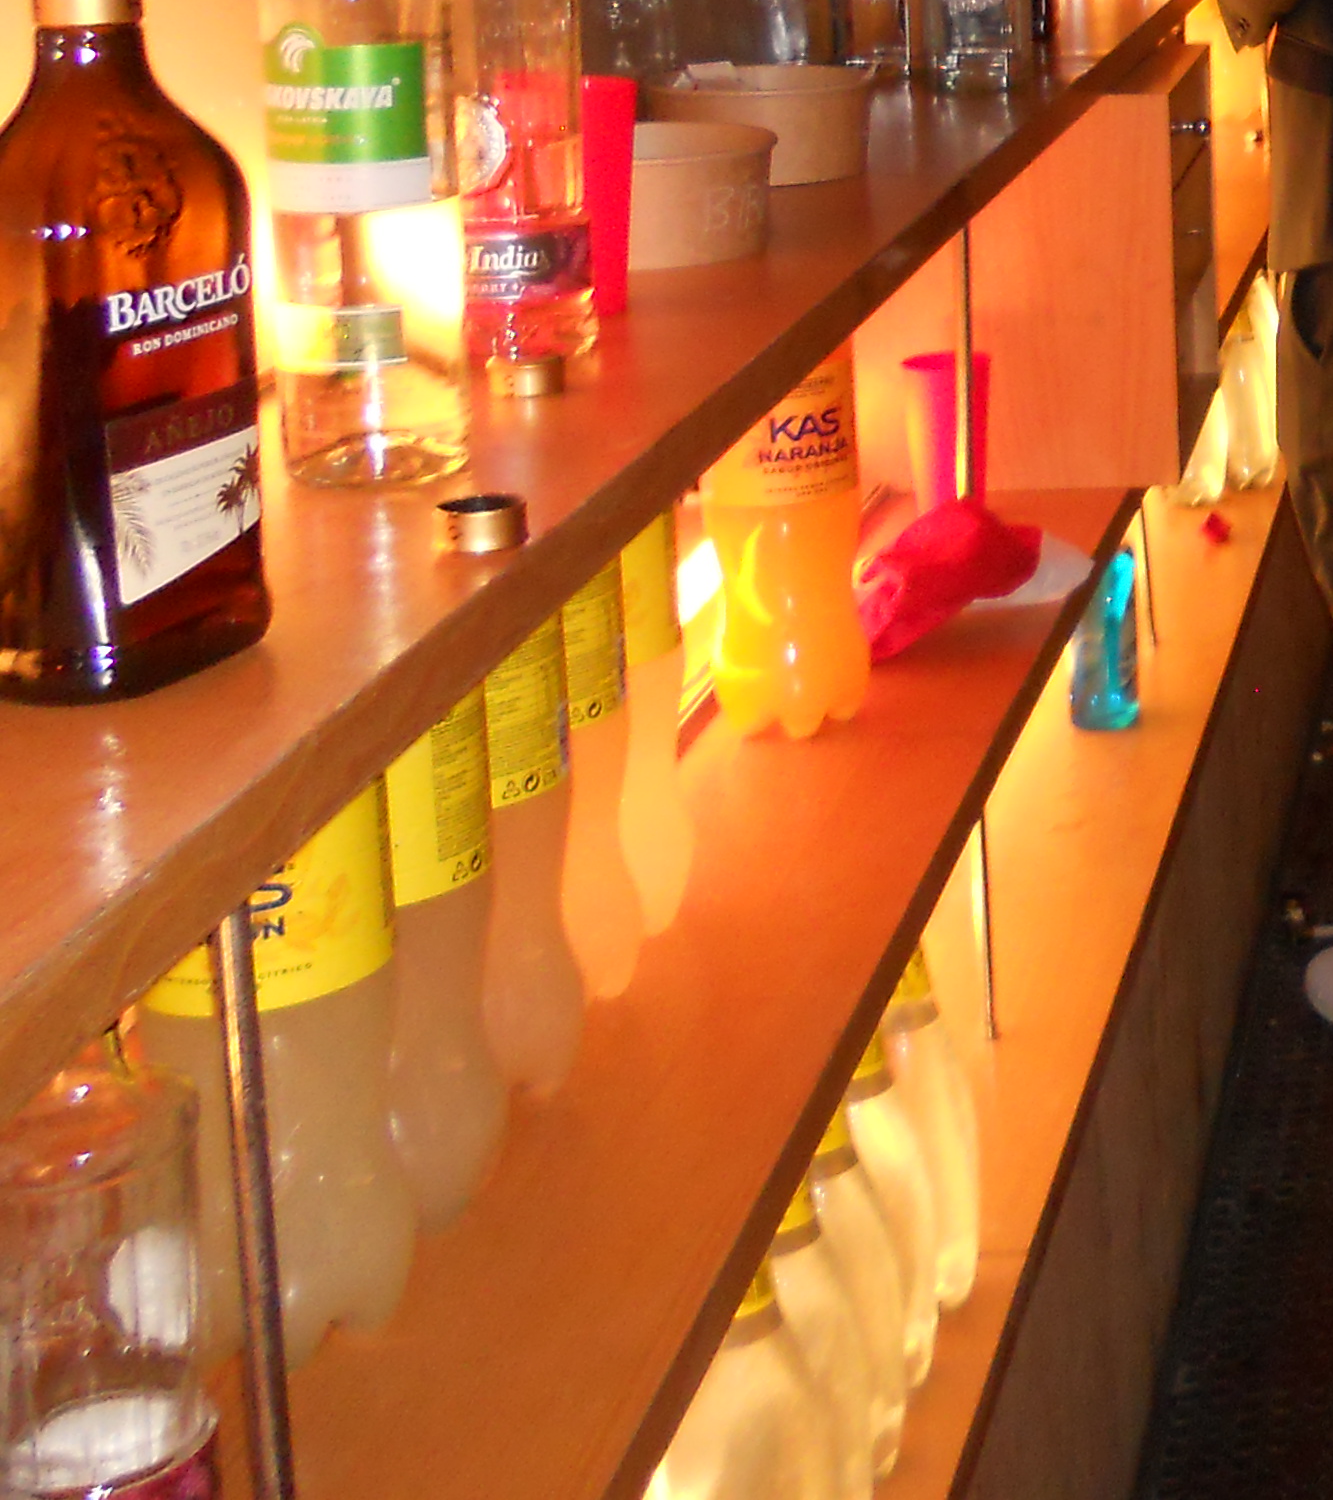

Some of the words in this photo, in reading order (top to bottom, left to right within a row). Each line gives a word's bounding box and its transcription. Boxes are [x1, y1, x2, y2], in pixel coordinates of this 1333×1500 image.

[107, 253, 251, 333] BARCELÓ
[132, 337, 162, 356] RON
[164, 313, 239, 347] DOMINICANO
[769, 405, 841, 444] KAS
